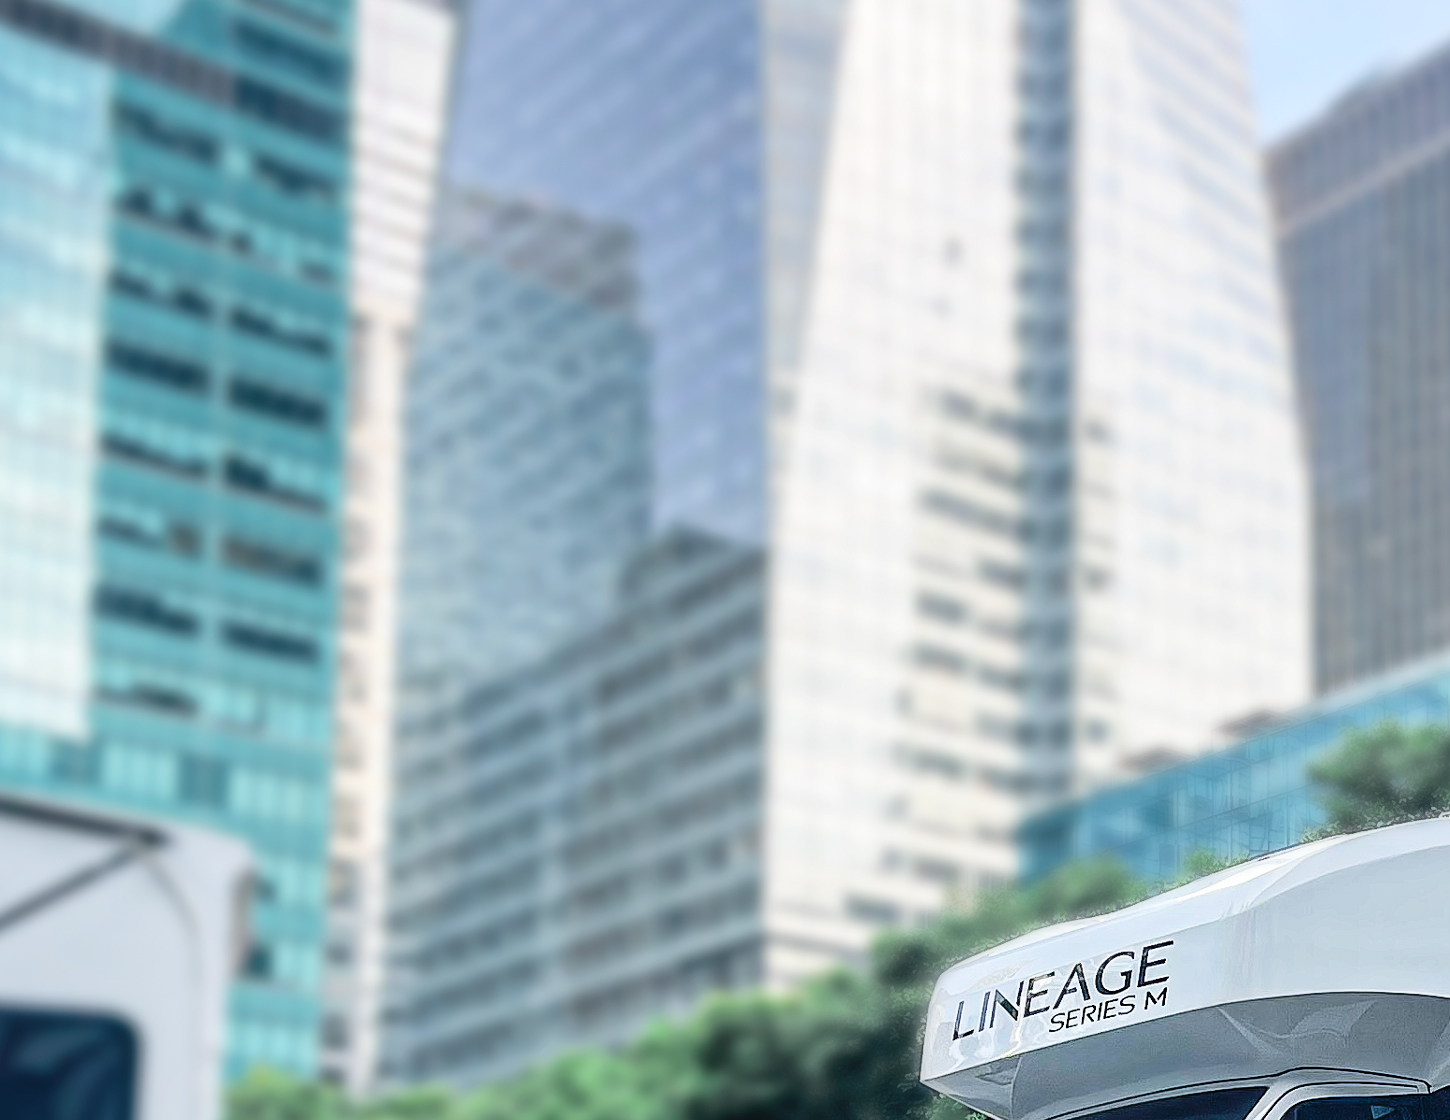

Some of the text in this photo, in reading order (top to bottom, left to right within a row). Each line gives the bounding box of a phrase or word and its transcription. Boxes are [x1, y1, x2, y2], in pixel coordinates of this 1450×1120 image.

[952, 940, 1174, 1041] LINEAGE
[1049, 987, 1169, 1032] SERIES M
